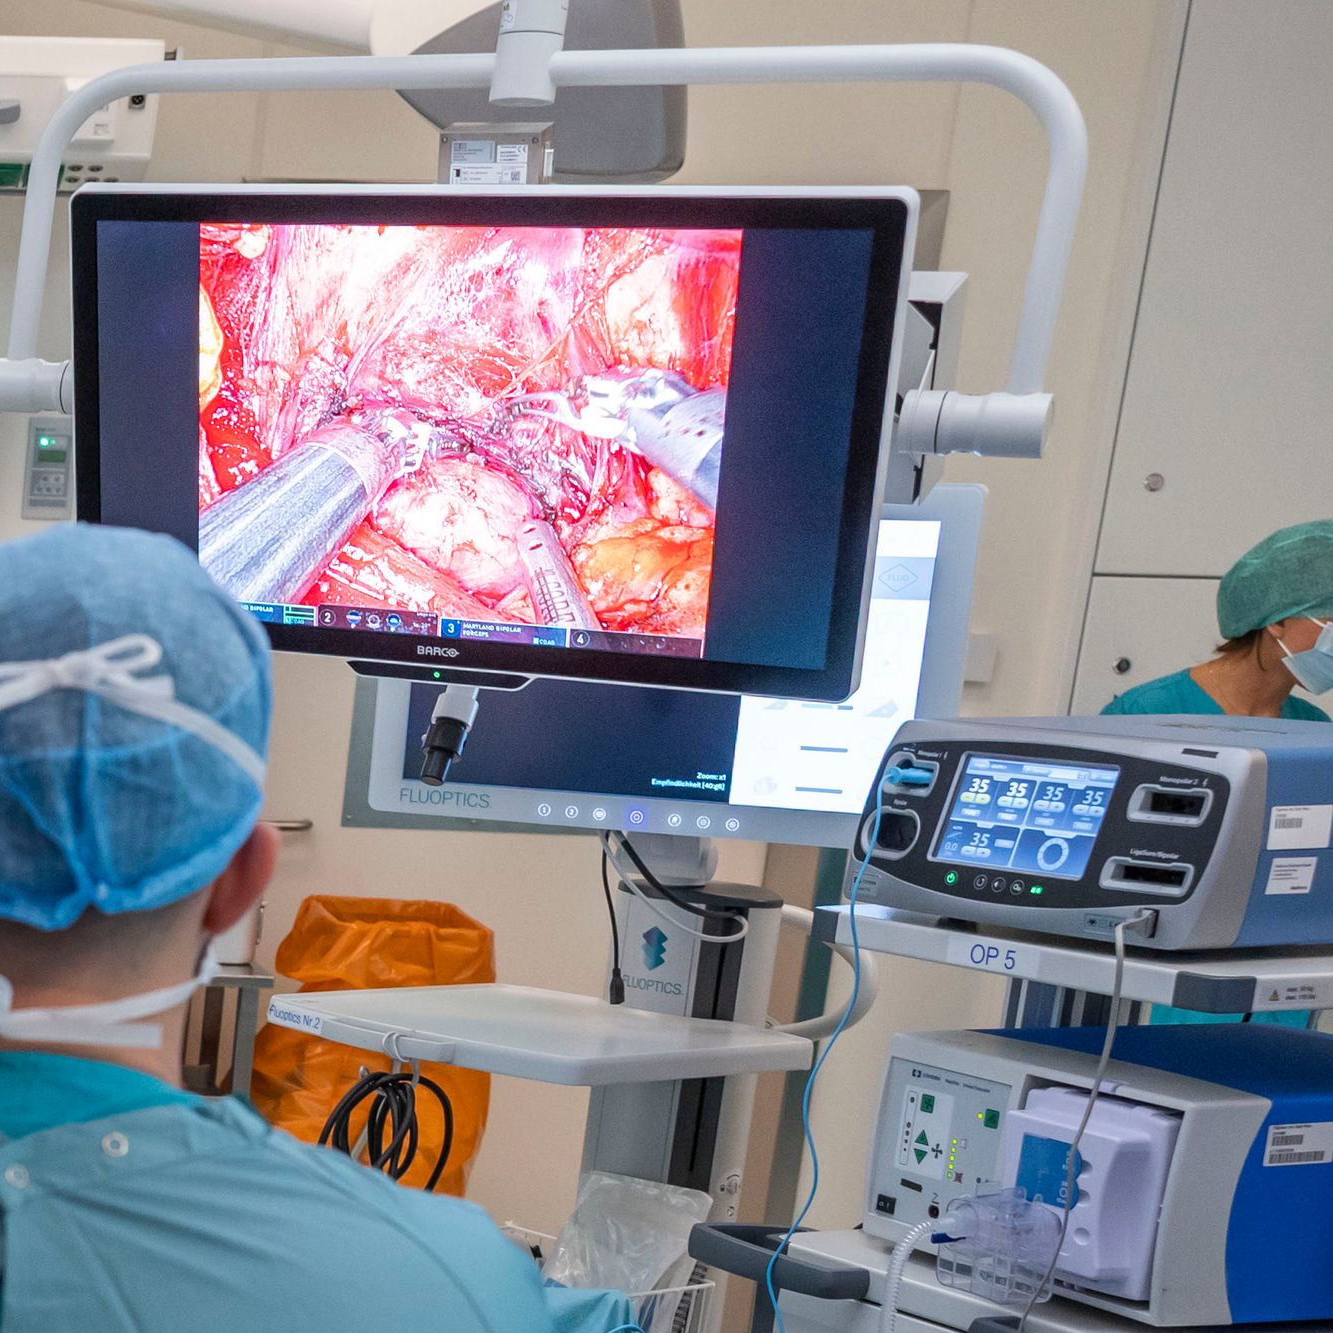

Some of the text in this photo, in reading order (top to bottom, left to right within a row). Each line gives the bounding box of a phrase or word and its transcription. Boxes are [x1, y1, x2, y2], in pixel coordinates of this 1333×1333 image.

[324, 612, 331, 623] 2
[446, 623, 454, 633] 3
[576, 633, 584, 644] 4
[416, 645, 460, 658] BARCO
[697, 772, 718, 780] Zoom:
[969, 778, 1104, 805] 35 35 35 35
[970, 832, 991, 847] 35
[970, 944, 1016, 970] OP 5
